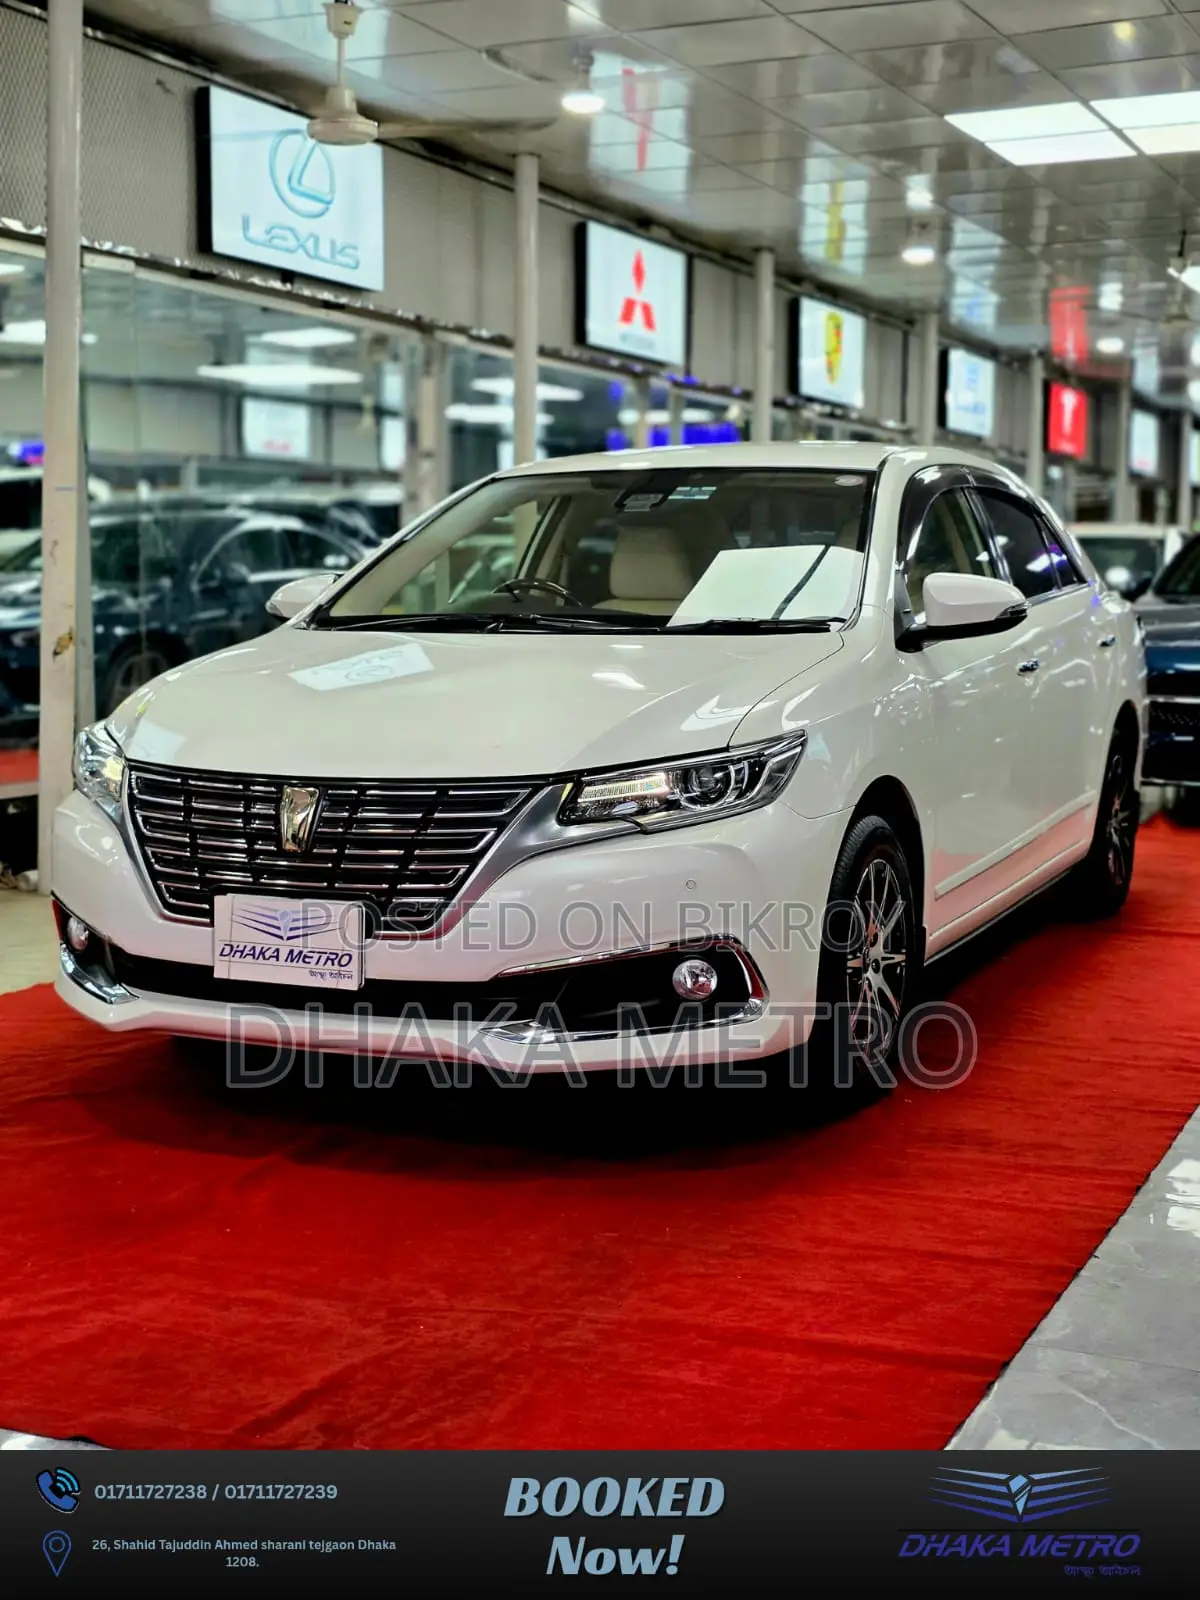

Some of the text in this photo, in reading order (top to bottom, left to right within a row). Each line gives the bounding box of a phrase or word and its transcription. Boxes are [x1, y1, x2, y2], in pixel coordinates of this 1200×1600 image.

[242, 213, 360, 270] LEXUS
[218, 943, 353, 968] DHAKA METRO
